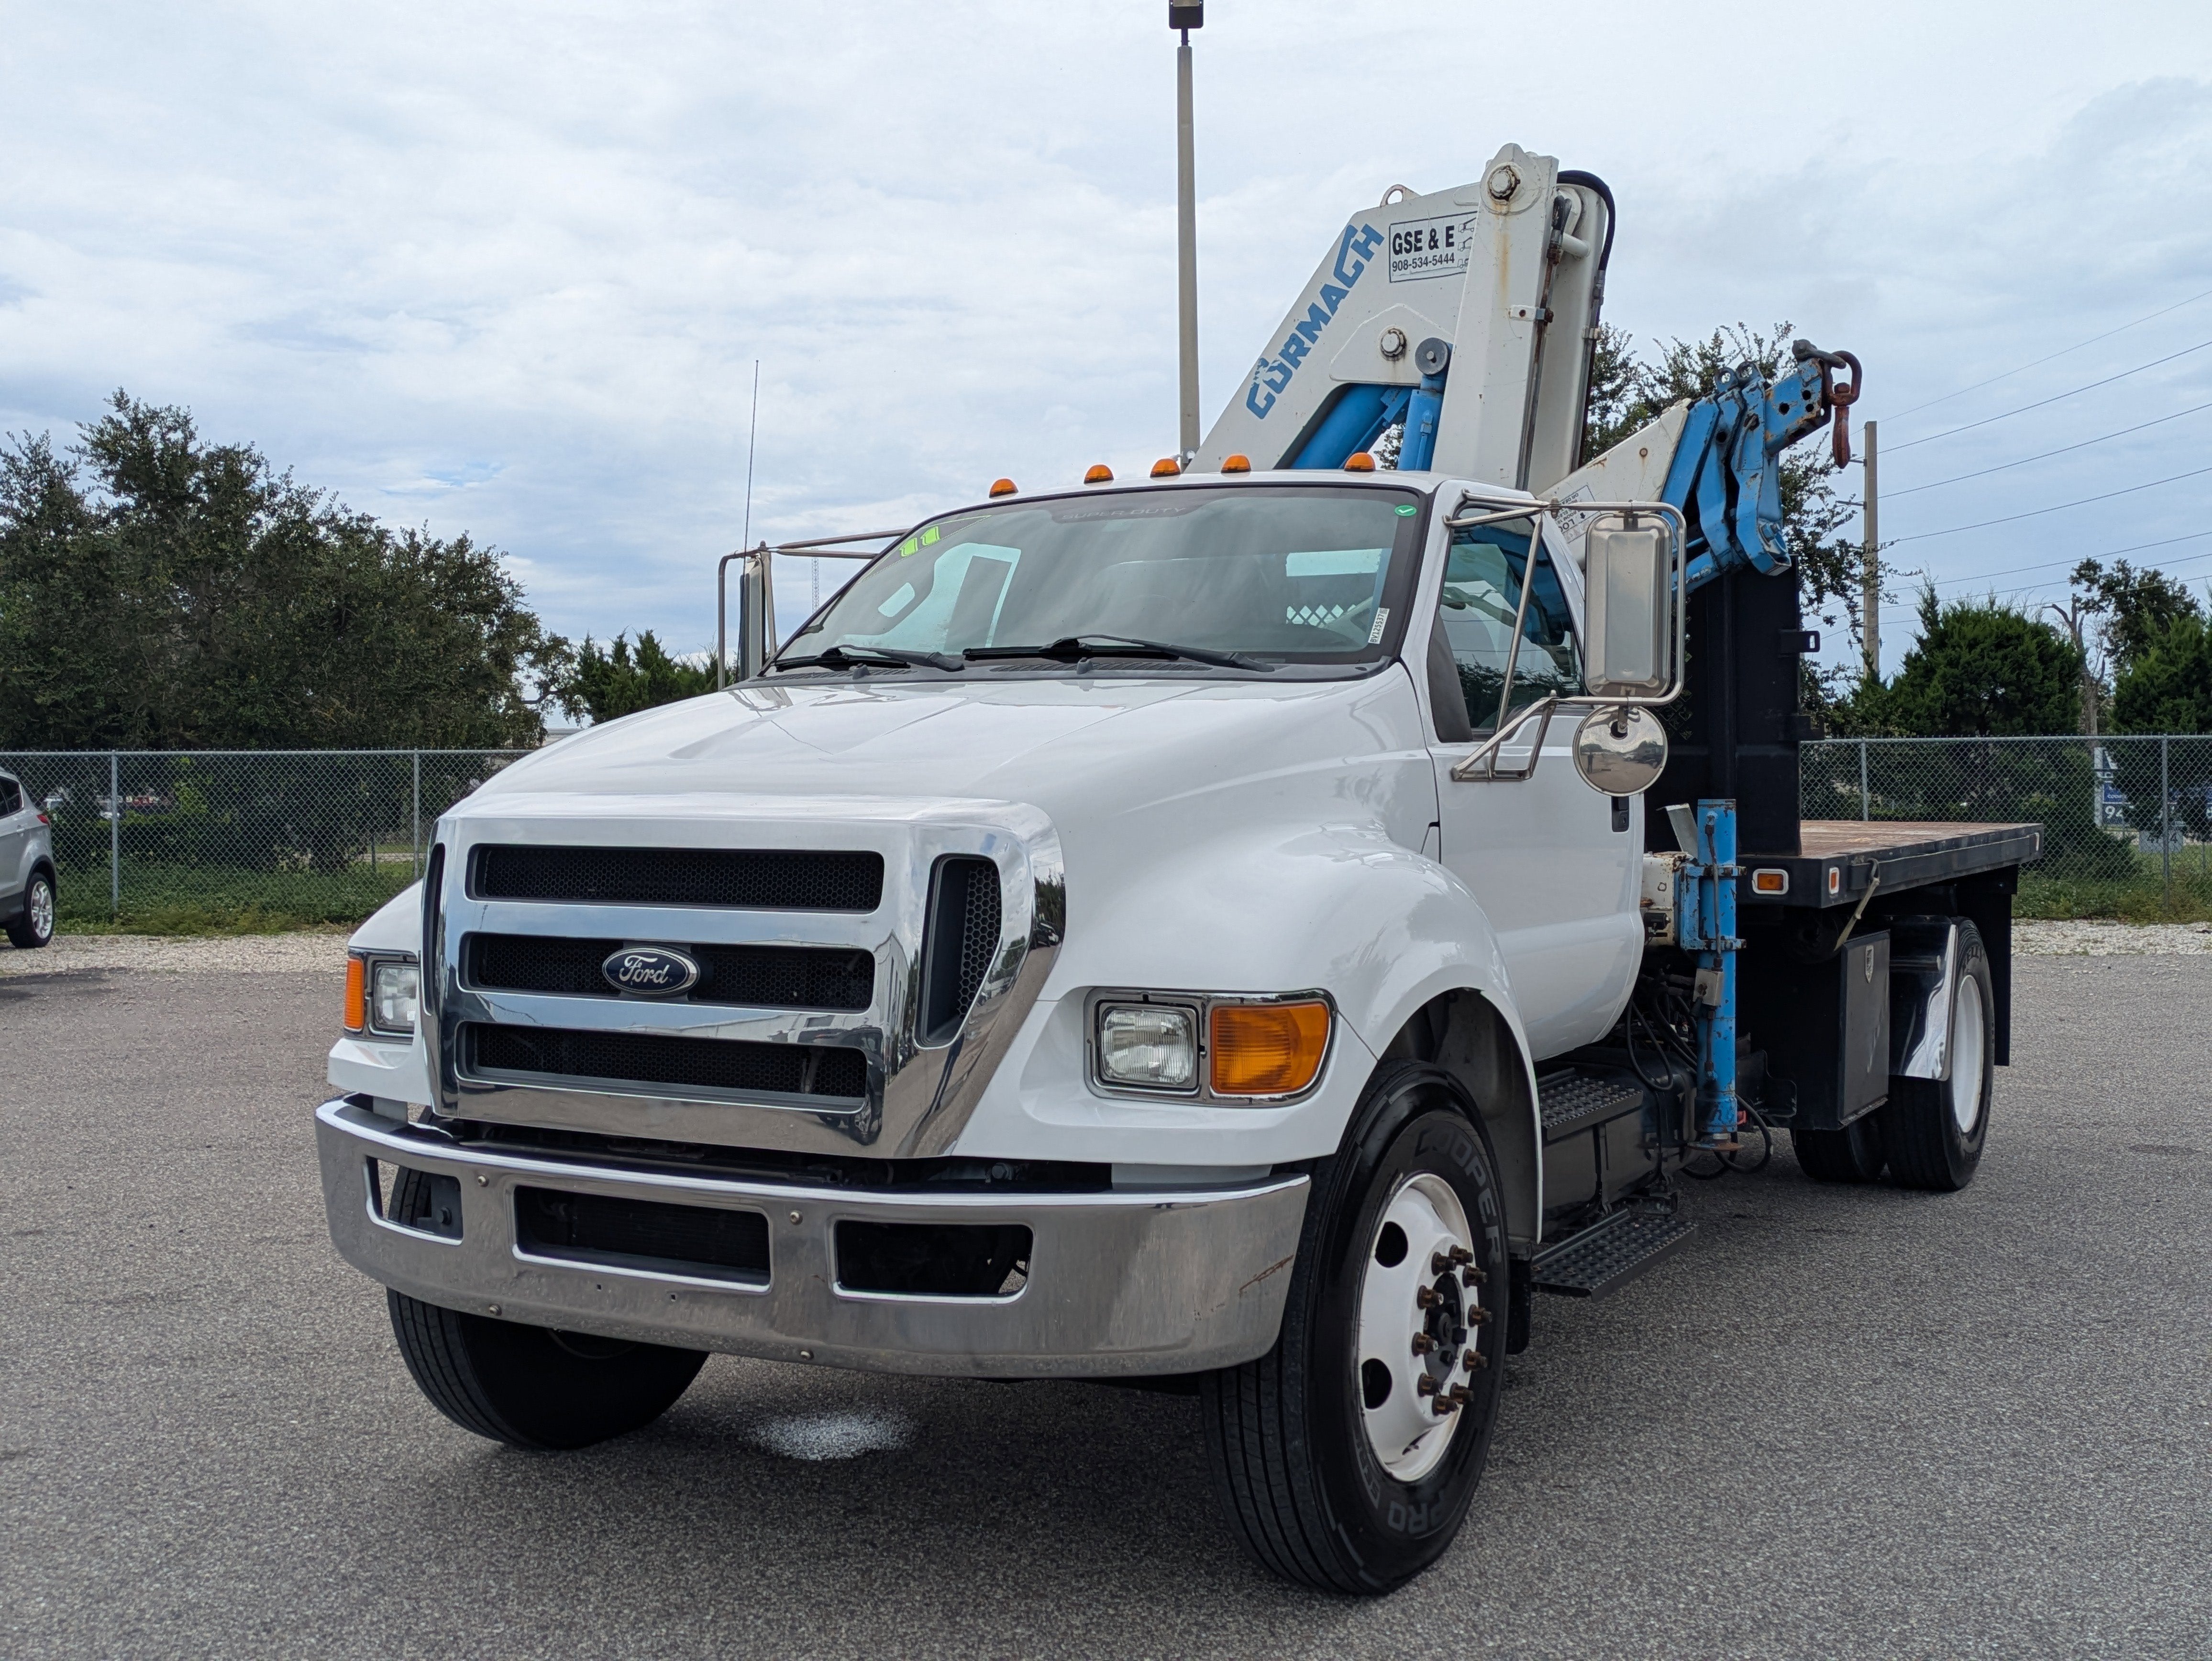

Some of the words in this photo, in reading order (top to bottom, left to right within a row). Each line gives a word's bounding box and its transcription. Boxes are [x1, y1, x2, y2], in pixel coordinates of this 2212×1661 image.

[1393, 230, 1423, 255] GSE
[1428, 228, 1439, 250] &
[1446, 225, 1455, 247] E
[1393, 252, 1455, 272] 908-534-5444
[1062, 510, 1124, 520] SUPER
[1370, 614, 1384, 642] BV125537
[619, 955, 670, 985] Ford
[1415, 1128, 1502, 1266] COOPER
